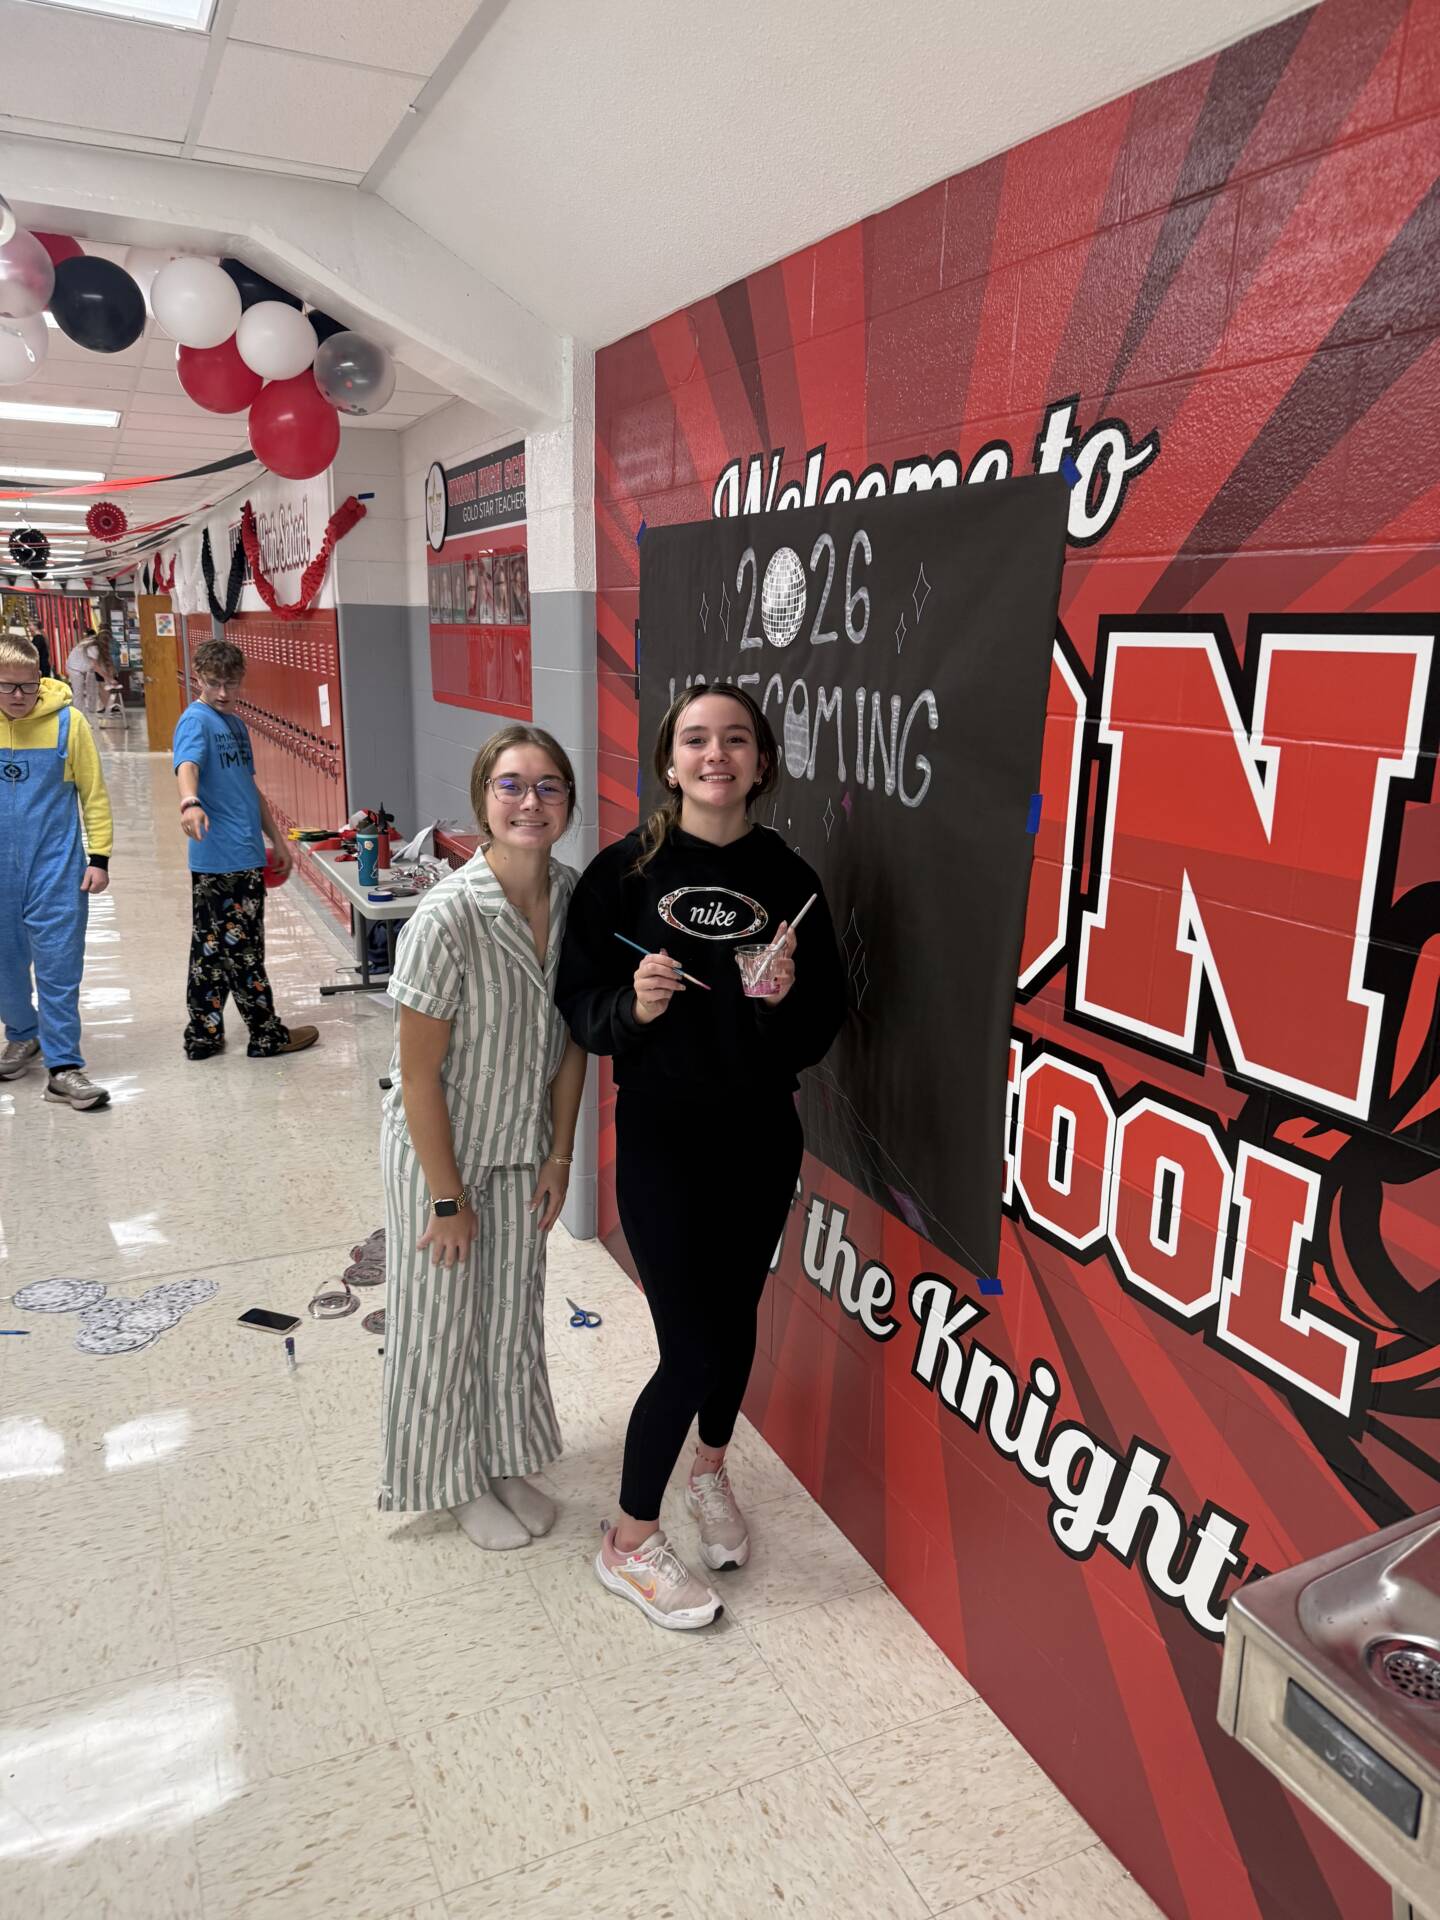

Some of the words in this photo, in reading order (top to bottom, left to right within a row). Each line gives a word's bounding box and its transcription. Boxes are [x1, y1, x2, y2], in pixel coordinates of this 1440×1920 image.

[463, 504, 478, 522] GOLD
[479, 499, 494, 519] STAR
[736, 529, 873, 652] 2026
[689, 901, 737, 927] nike
[803, 1198, 896, 1336] the
[911, 1279, 1232, 1634] Knight
